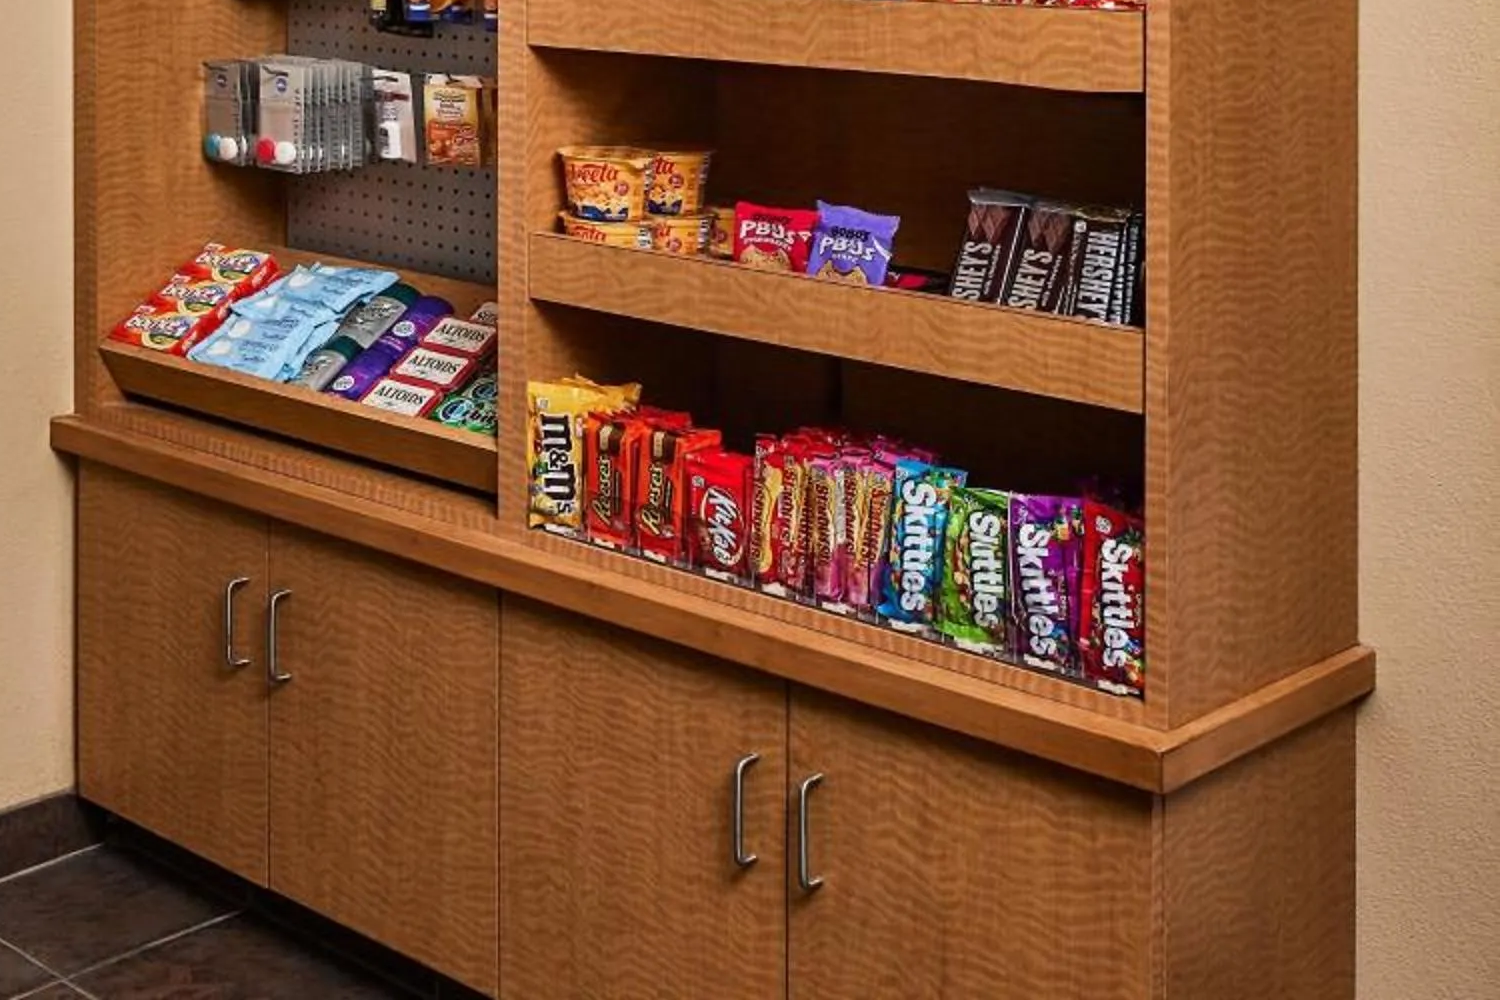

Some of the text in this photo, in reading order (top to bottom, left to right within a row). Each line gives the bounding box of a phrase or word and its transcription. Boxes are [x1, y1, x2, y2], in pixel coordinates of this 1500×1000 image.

[409, 353, 462, 374] ALTOIDS
[436, 322, 486, 343] ALTOIDS
[374, 384, 427, 405] ALTOIDS
[901, 479, 939, 612] Skittles
[969, 511, 1005, 629] Skittles
[1017, 523, 1060, 656] Skittles
[1101, 538, 1136, 668] Skittles
